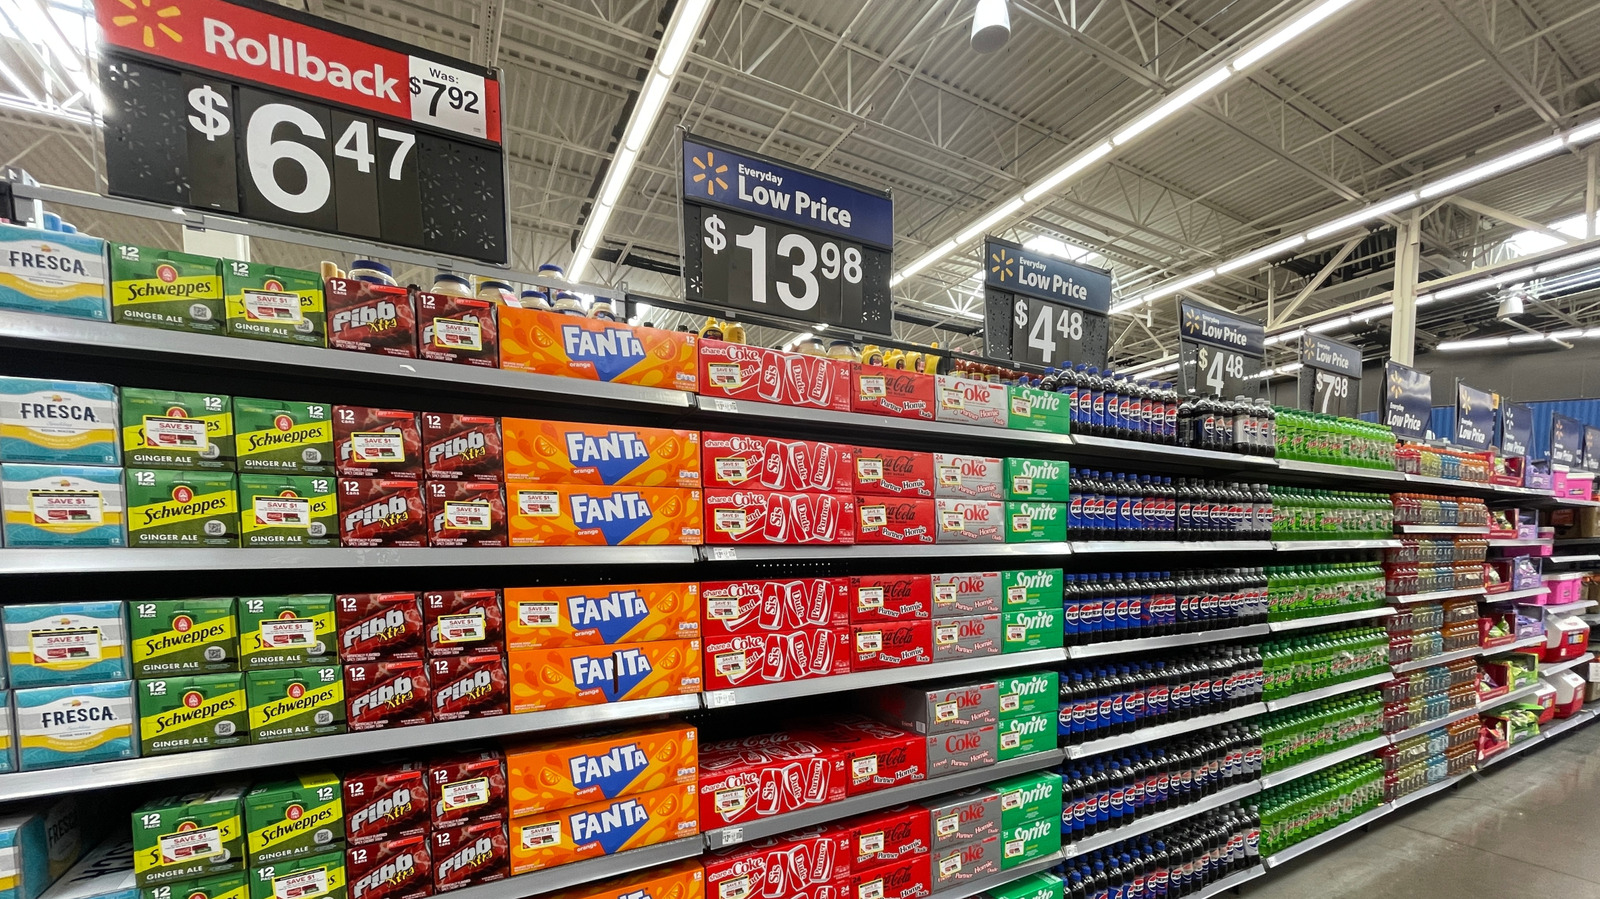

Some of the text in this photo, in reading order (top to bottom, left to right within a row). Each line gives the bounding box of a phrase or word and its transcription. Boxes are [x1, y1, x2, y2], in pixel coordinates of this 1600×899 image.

[203, 17, 401, 102] Rollback
[429, 66, 459, 84] Was:
[738, 163, 783, 186] Everyday
[738, 175, 851, 227] Low Price
[119, 246, 139, 257] 12
[9, 251, 85, 276] FRESCA
[231, 262, 249, 272] 12
[1019, 257, 1046, 271] Everyday
[128, 280, 211, 301] Schweppes
[331, 280, 346, 292] 12
[1018, 266, 1087, 300] Low Price
[124, 309, 182, 323] GINGER ALE
[333, 301, 396, 332] Pibb
[563, 326, 645, 358] FANTA
[1202, 320, 1247, 346] Low Price
[701, 347, 722, 355] share
[727, 346, 758, 361] Coke
[1316, 348, 1349, 369] Low Price
[569, 361, 591, 369] orange
[764, 365, 777, 385] Sis
[793, 364, 805, 394] Dude
[203, 397, 222, 407] 12
[307, 406, 324, 415] 12
[21, 403, 96, 422] FRESCA
[1387, 410, 1422, 430] Low Price
[249, 427, 322, 451] Schweppes
[1459, 425, 1485, 443] Low Price
[429, 431, 485, 463] Pibb
[566, 432, 647, 462] FANTA
[730, 437, 762, 451] Coke
[134, 454, 172, 462] GINGER
[245, 459, 279, 467] GINGER
[767, 453, 780, 473] Sis
[795, 451, 808, 480] Dude
[135, 472, 154, 482] 12
[573, 467, 595, 475] orange
[1021, 461, 1059, 480] Sprite
[311, 479, 328, 489] 12
[48, 497, 72, 505] SAVE
[570, 492, 650, 523] FANTA
[733, 492, 764, 506] Coke
[144, 497, 225, 524] Schweppes
[346, 497, 407, 532] Pibb
[1021, 503, 1056, 521] Sprite
[140, 533, 178, 542] GINGER
[577, 529, 598, 537] orange
[1015, 570, 1053, 589] Sprite
[688, 585, 697, 594] 12
[727, 583, 760, 597] Coke
[137, 604, 157, 614] 12
[568, 591, 647, 625] FANTA
[764, 596, 777, 615] Sis
[343, 610, 405, 648] Pibb
[1016, 611, 1054, 630] Sprite
[47, 635, 84, 644] SAVE $1
[146, 624, 224, 655] Schweppes
[574, 630, 596, 638] orange
[731, 636, 763, 650] Coke
[251, 654, 301, 664] GINGER ALE
[795, 640, 807, 668] Dude
[143, 661, 199, 671] GINGER ALE
[572, 650, 651, 683] FANTA
[437, 670, 490, 708] Pibb
[578, 689, 599, 697] orange
[1010, 676, 1048, 696] Sprite
[352, 676, 412, 716] Pibb
[156, 697, 235, 732] Schweppes
[262, 689, 333, 723] Schweppes
[42, 706, 113, 728] FRESCA
[1010, 715, 1048, 736] Sprite
[259, 726, 309, 737] GINGER ALE
[153, 737, 208, 748] GINGER ALE
[945, 734, 981, 753] Coke
[569, 744, 647, 784] FANTA
[726, 772, 757, 788] Coke
[317, 787, 333, 797] 12
[576, 787, 598, 796] orange
[141, 814, 161, 825] 12
[351, 788, 410, 833] Pibb
[570, 799, 647, 841] FANTA
[261, 808, 331, 846] Schweppes
[1014, 822, 1050, 843] Sprite
[174, 834, 196, 844] SAVE
[576, 843, 598, 852] orange
[258, 846, 308, 861] GINGER ALE
[439, 838, 492, 879] Pibb
[146, 866, 202, 880] GINGER ALE
[732, 857, 763, 876] Coke
[354, 854, 414, 899] Pibb
